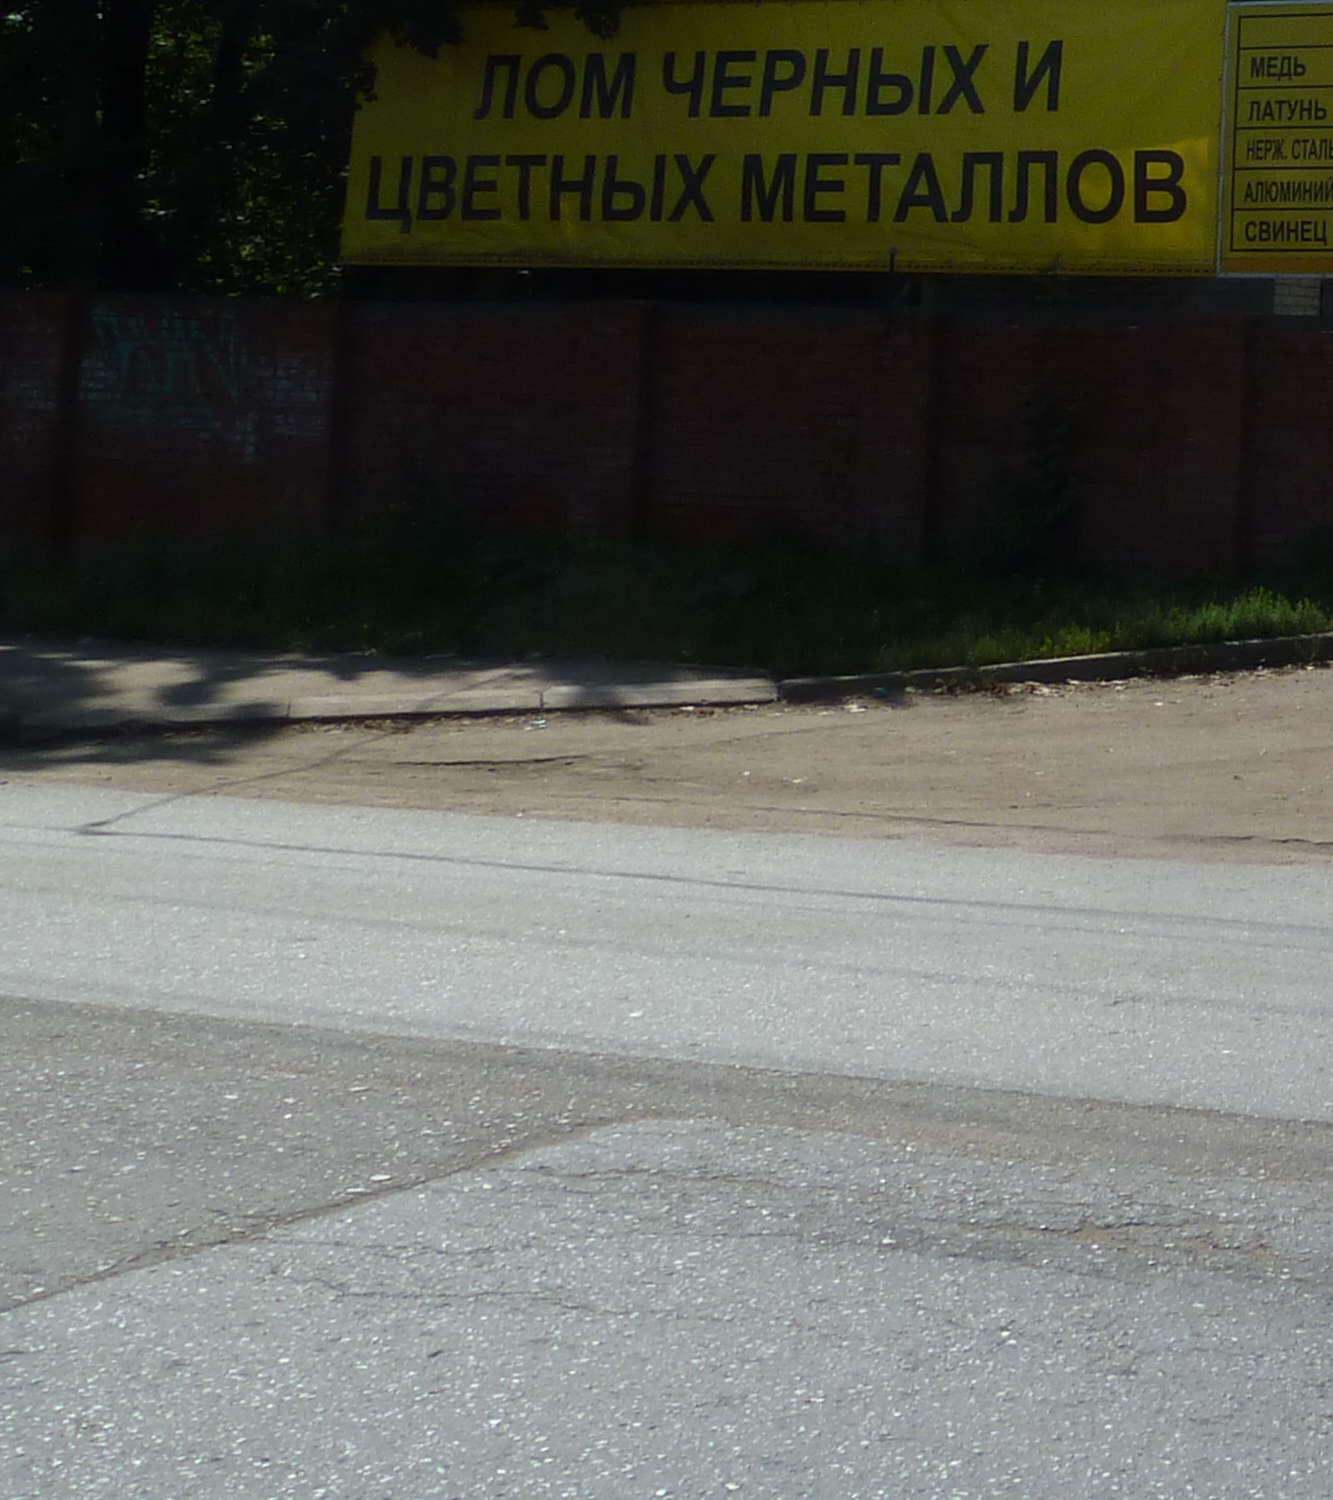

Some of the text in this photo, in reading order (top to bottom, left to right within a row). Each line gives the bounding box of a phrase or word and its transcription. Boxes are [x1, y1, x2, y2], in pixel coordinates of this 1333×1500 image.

[473, 40, 1065, 121] ЛОМ ЧЕРНЫХ И
[1250, 56, 1306, 81] МЕДЬ
[1247, 99, 1328, 122] ЛАТУНЬ
[1246, 139, 1288, 161] НЕРЖ.
[364, 149, 1189, 235] ЦВЕТНЫХ МЕТАЛЛОВ
[1245, 220, 1328, 247] СВИНЕЦ
